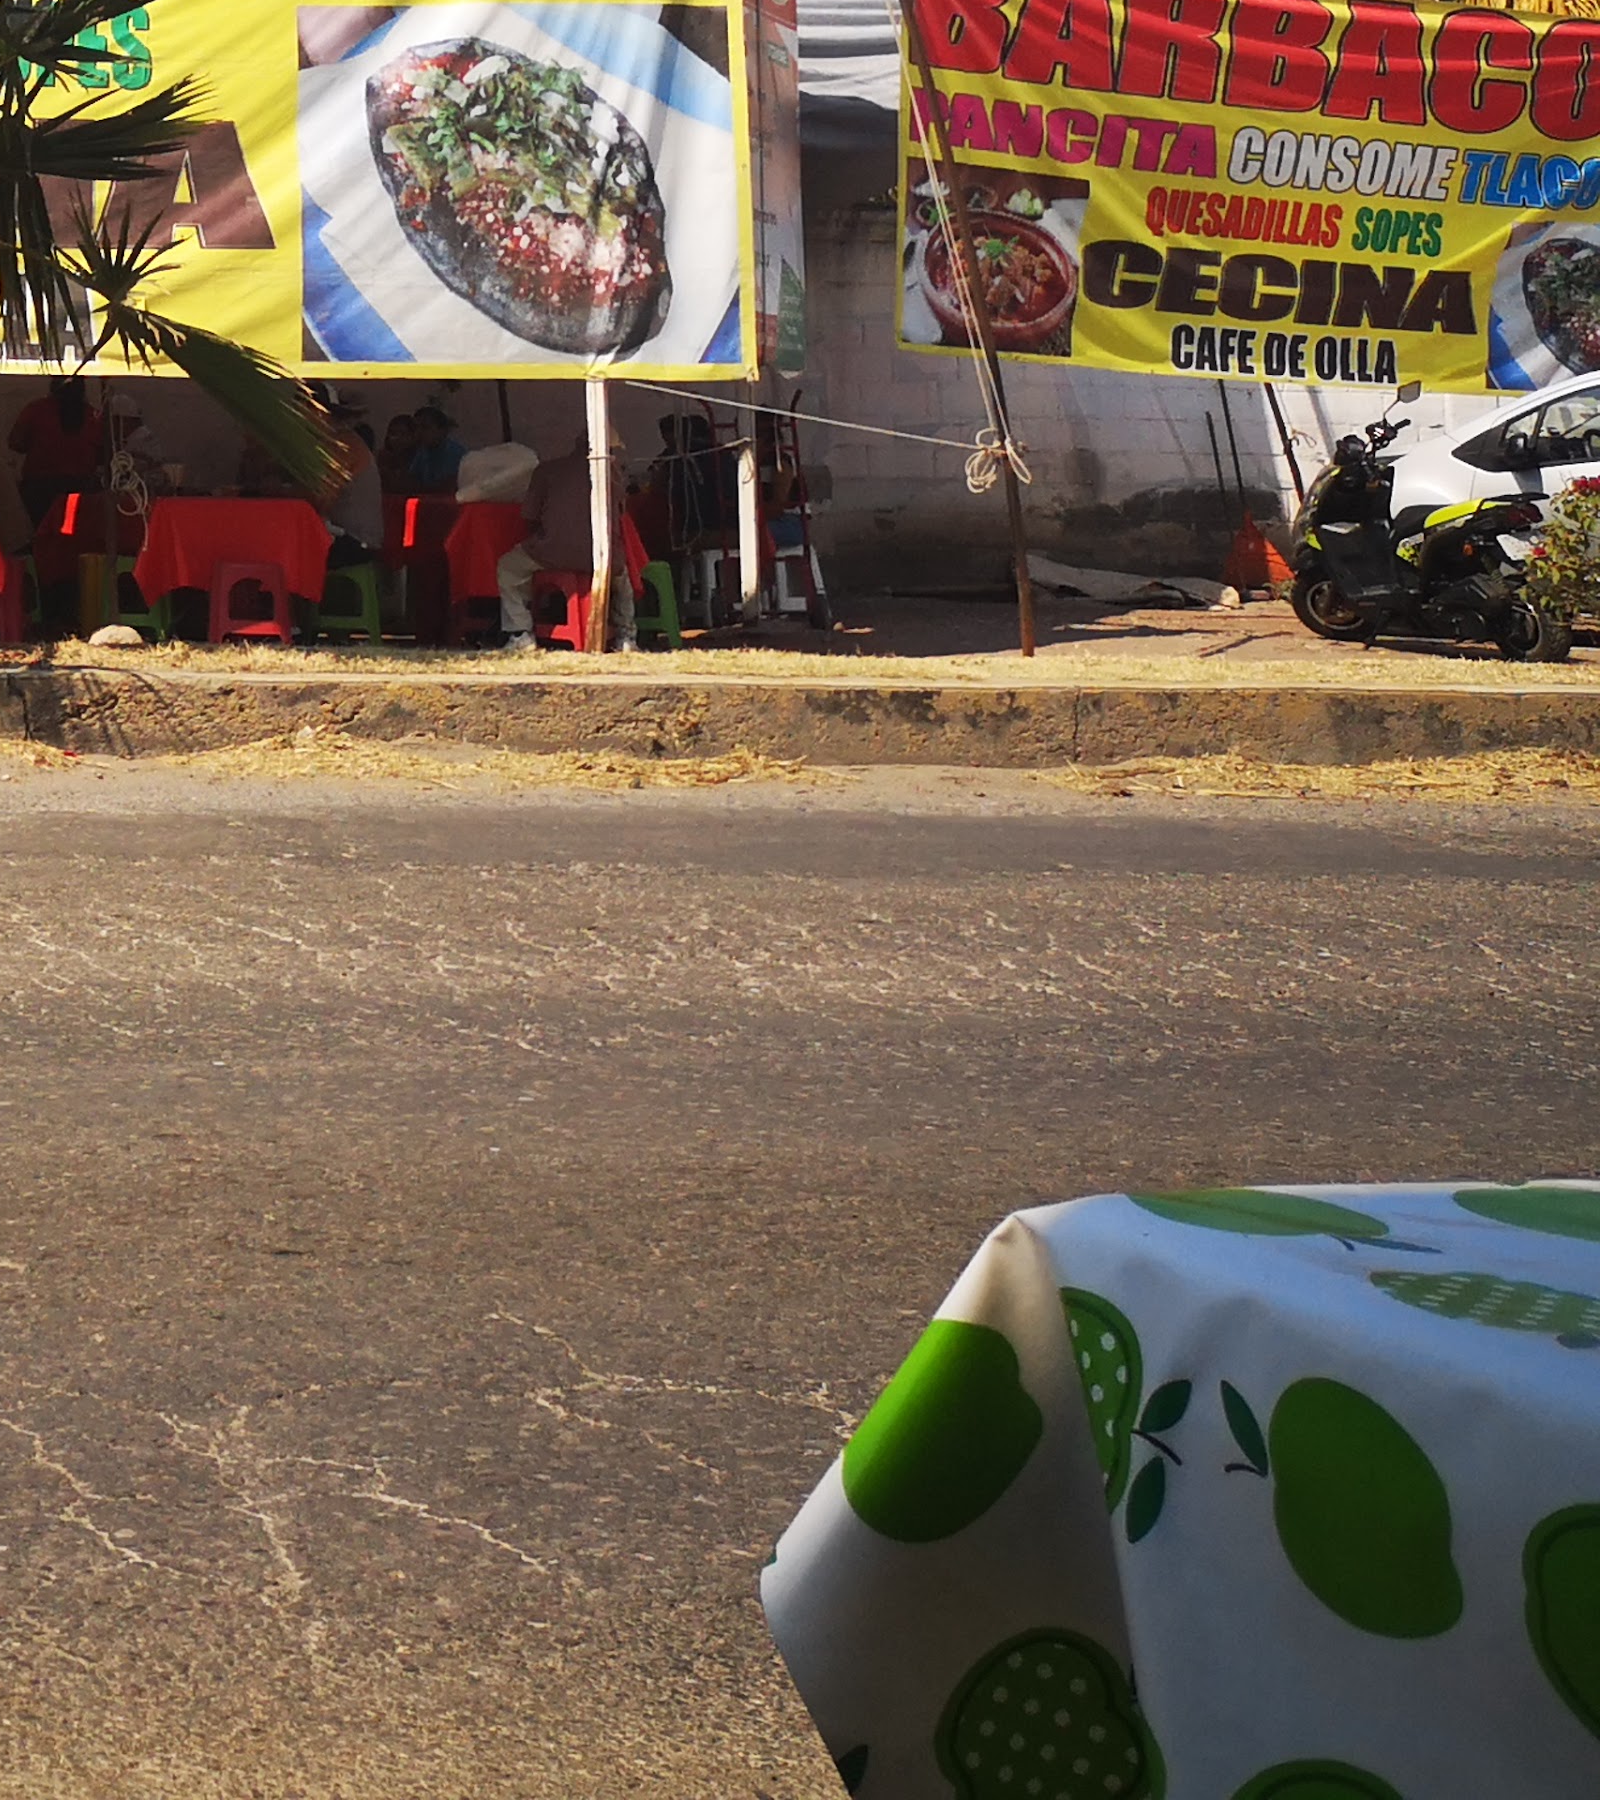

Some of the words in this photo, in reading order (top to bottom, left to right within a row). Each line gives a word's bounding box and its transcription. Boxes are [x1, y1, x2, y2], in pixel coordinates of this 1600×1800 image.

[910, 87, 1216, 179] PANCITA
[1228, 125, 1459, 201] CONSOME
[1459, 149, 1600, 211] TLACO
[1145, 186, 1342, 248] QUESADILLAS
[1351, 206, 1443, 256] SOPES
[1082, 239, 1478, 335] CECINA
[1171, 323, 1256, 375] CAFE
[1264, 332, 1308, 378] DE
[1314, 335, 1398, 384] OLLA
